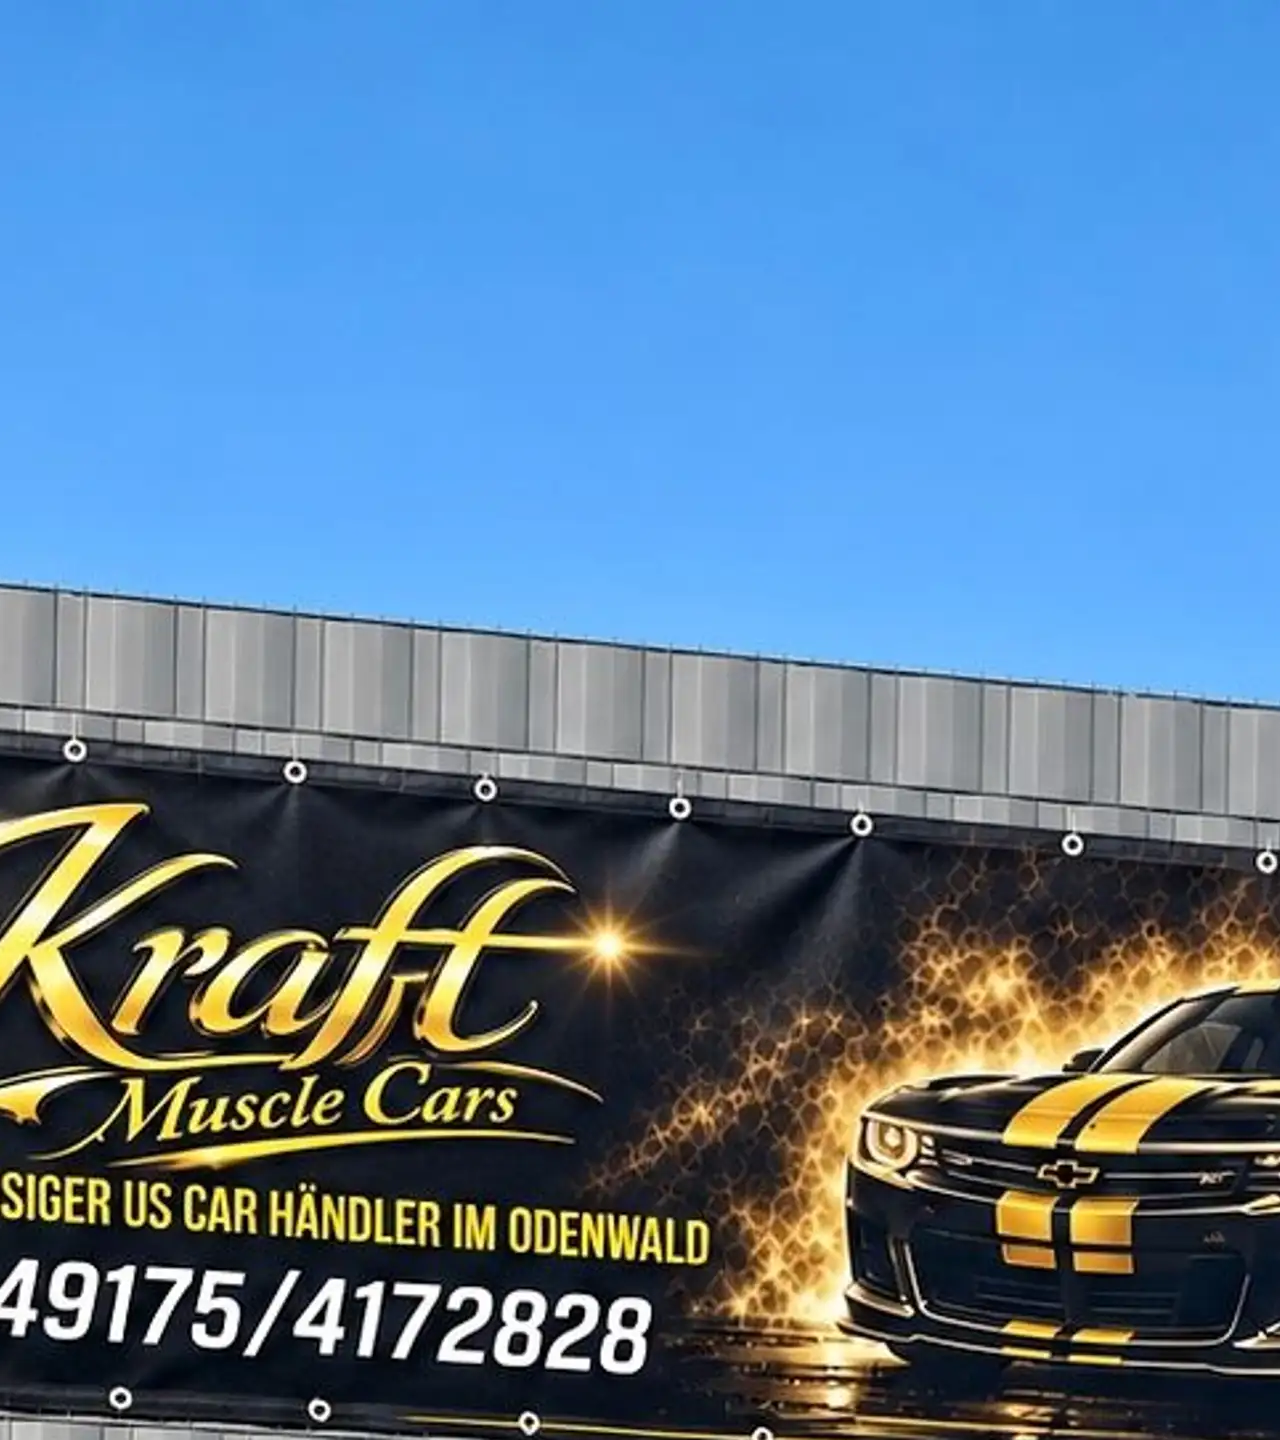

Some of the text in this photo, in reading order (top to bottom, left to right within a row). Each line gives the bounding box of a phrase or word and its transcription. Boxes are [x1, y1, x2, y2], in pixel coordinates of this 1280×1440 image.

[92, 1061, 518, 1148] Muscle Cars
[123, 1178, 173, 1231] US
[183, 1183, 257, 1235] CAR
[269, 1182, 442, 1248] HÄNDLER
[453, 1202, 496, 1252] IM
[508, 1206, 711, 1266] ODENWALD
